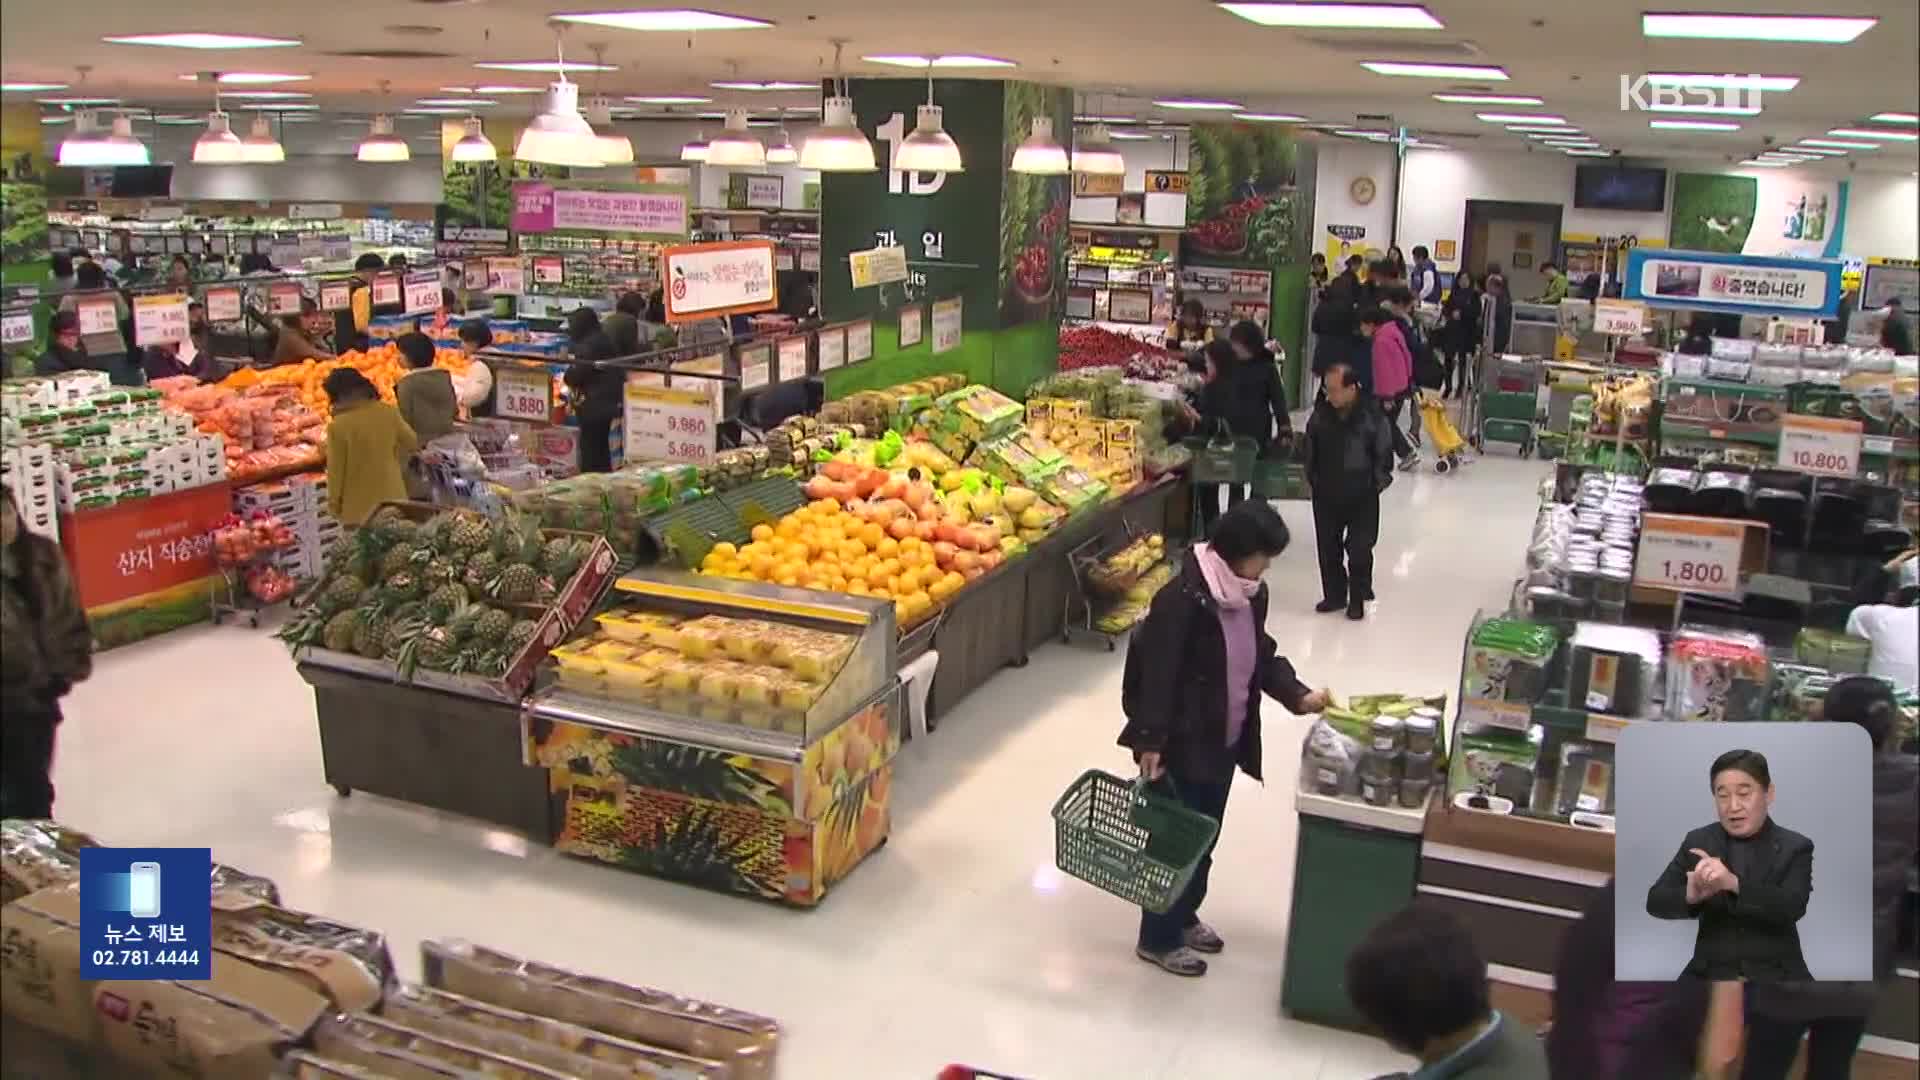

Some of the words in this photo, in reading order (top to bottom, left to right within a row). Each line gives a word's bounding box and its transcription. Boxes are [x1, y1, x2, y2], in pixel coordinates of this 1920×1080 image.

[1728, 277, 1806, 299] 줄였습니다!
[117, 545, 153, 577] 산지
[1664, 560, 1724, 583] 1,800
